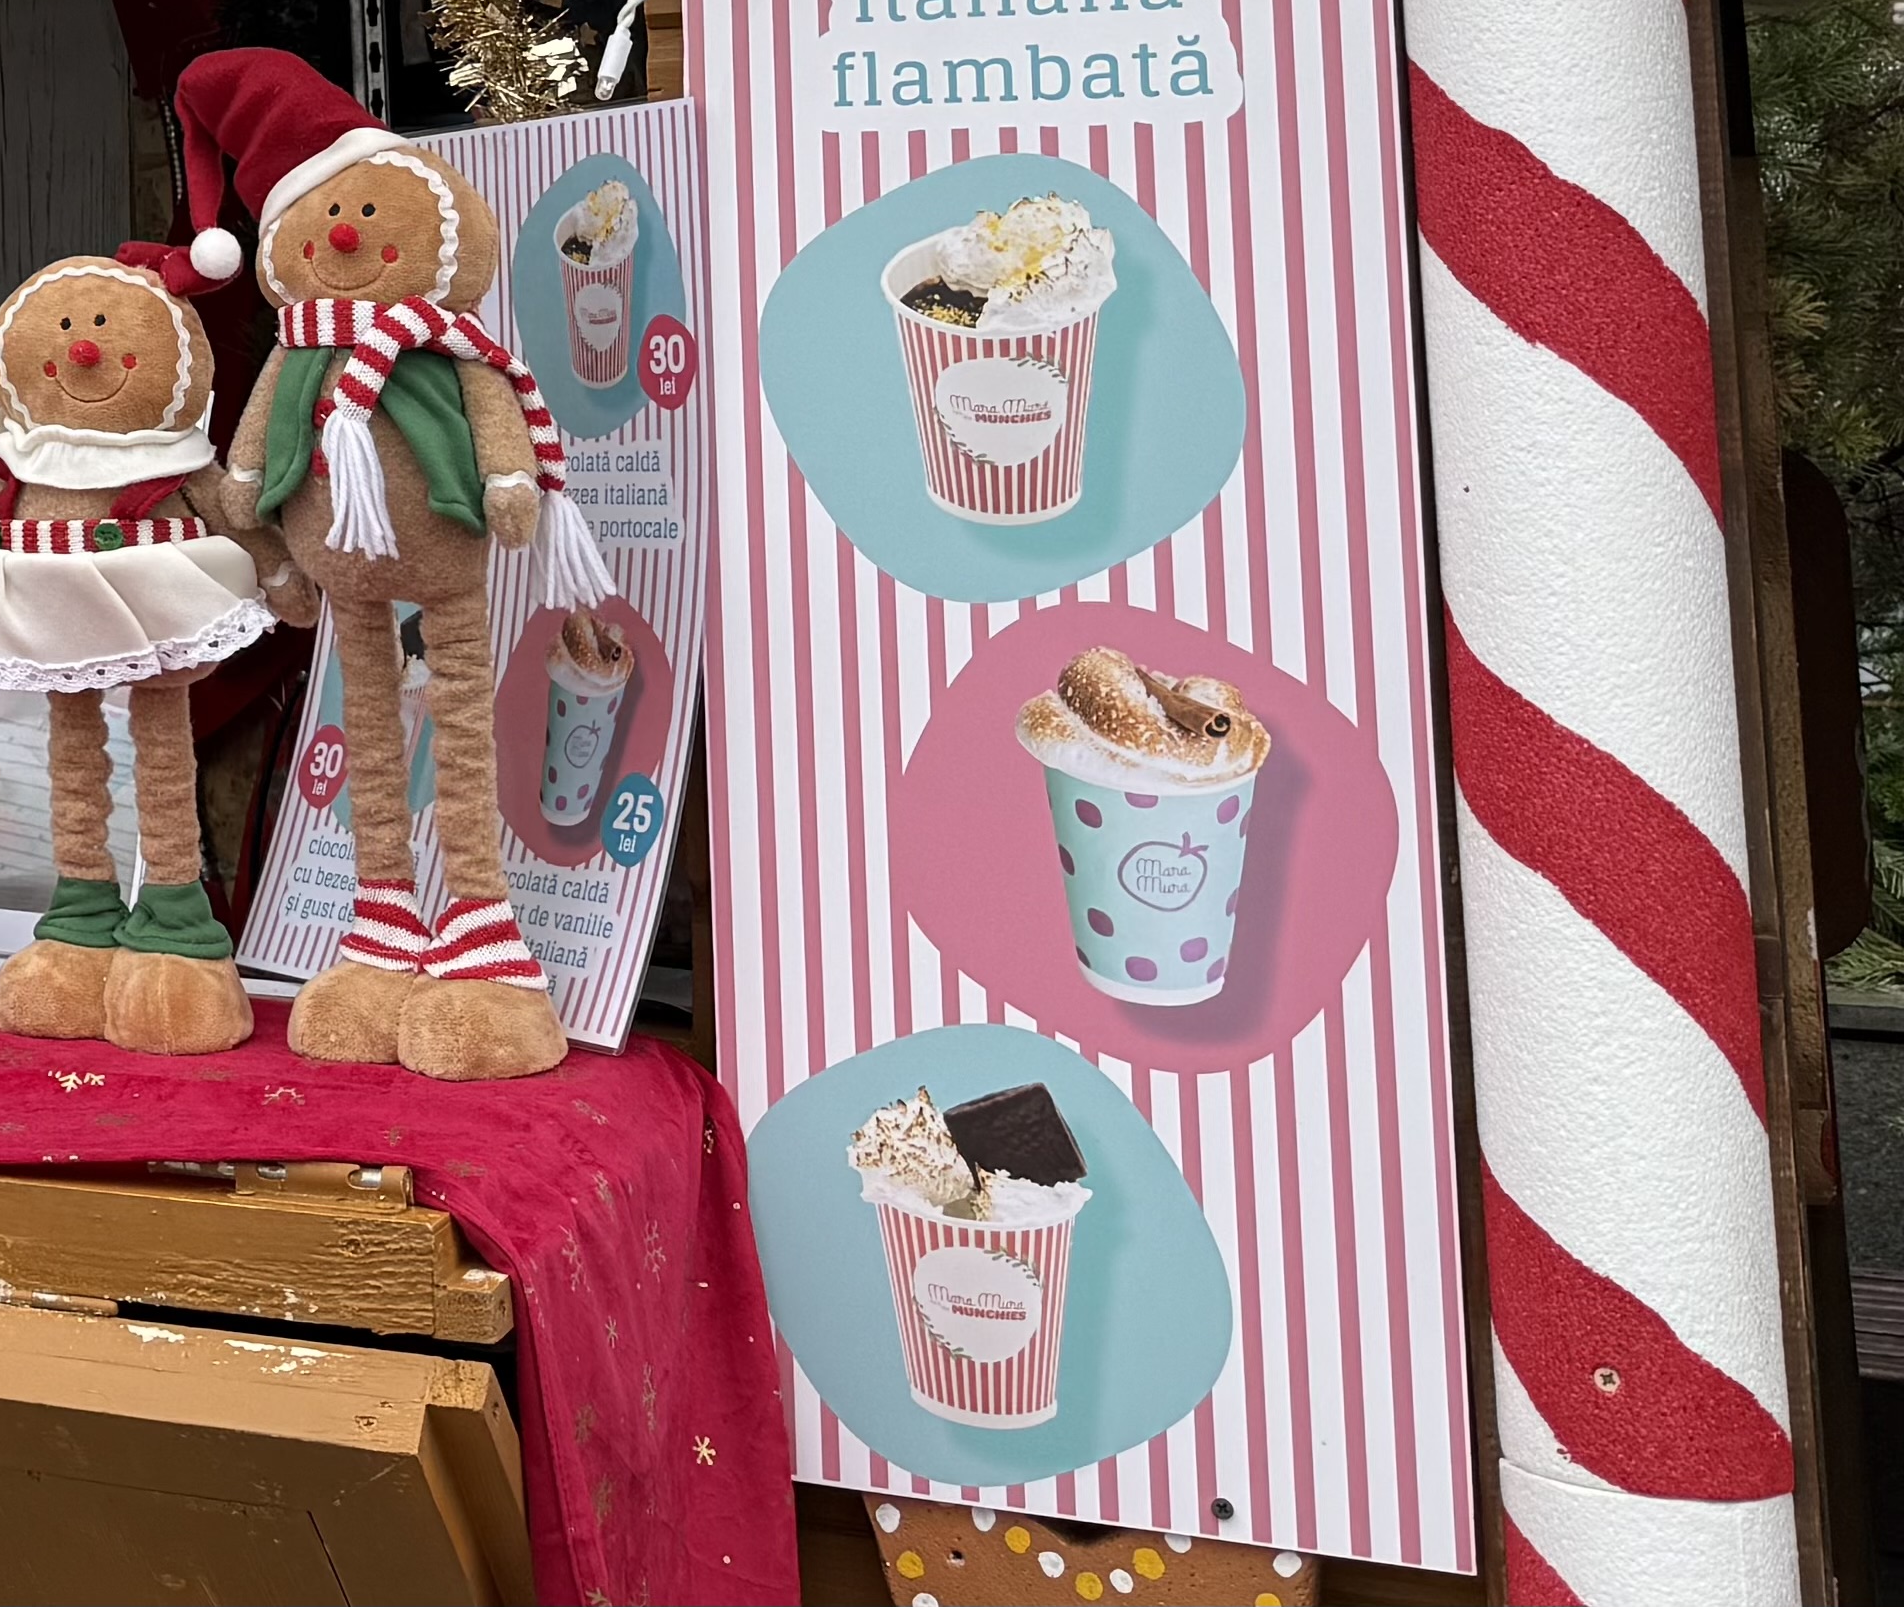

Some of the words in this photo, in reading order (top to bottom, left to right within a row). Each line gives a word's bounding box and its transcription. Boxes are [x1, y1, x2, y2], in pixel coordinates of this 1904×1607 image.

[831, 33, 1215, 109] flambată
[649, 334, 686, 374] 30
[659, 377, 676, 395] lei
[974, 410, 1052, 425] MUNCHIES
[616, 450, 661, 473] caldă
[604, 482, 668, 506] italiană
[598, 516, 679, 543] portocale
[309, 741, 344, 779] 30
[612, 791, 653, 834] 25
[308, 835, 355, 861] ciocol
[618, 834, 637, 855] lei
[293, 866, 313, 884] cu
[315, 866, 356, 892] bezea
[1135, 858, 1192, 877] Mara
[506, 870, 559, 895] colată
[561, 879, 610, 904] caldă
[285, 893, 302, 917] și
[300, 897, 336, 920] gust
[528, 905, 549, 928] de
[554, 911, 614, 939] vanilie
[951, 1304, 1027, 1321] MUNCHIES
